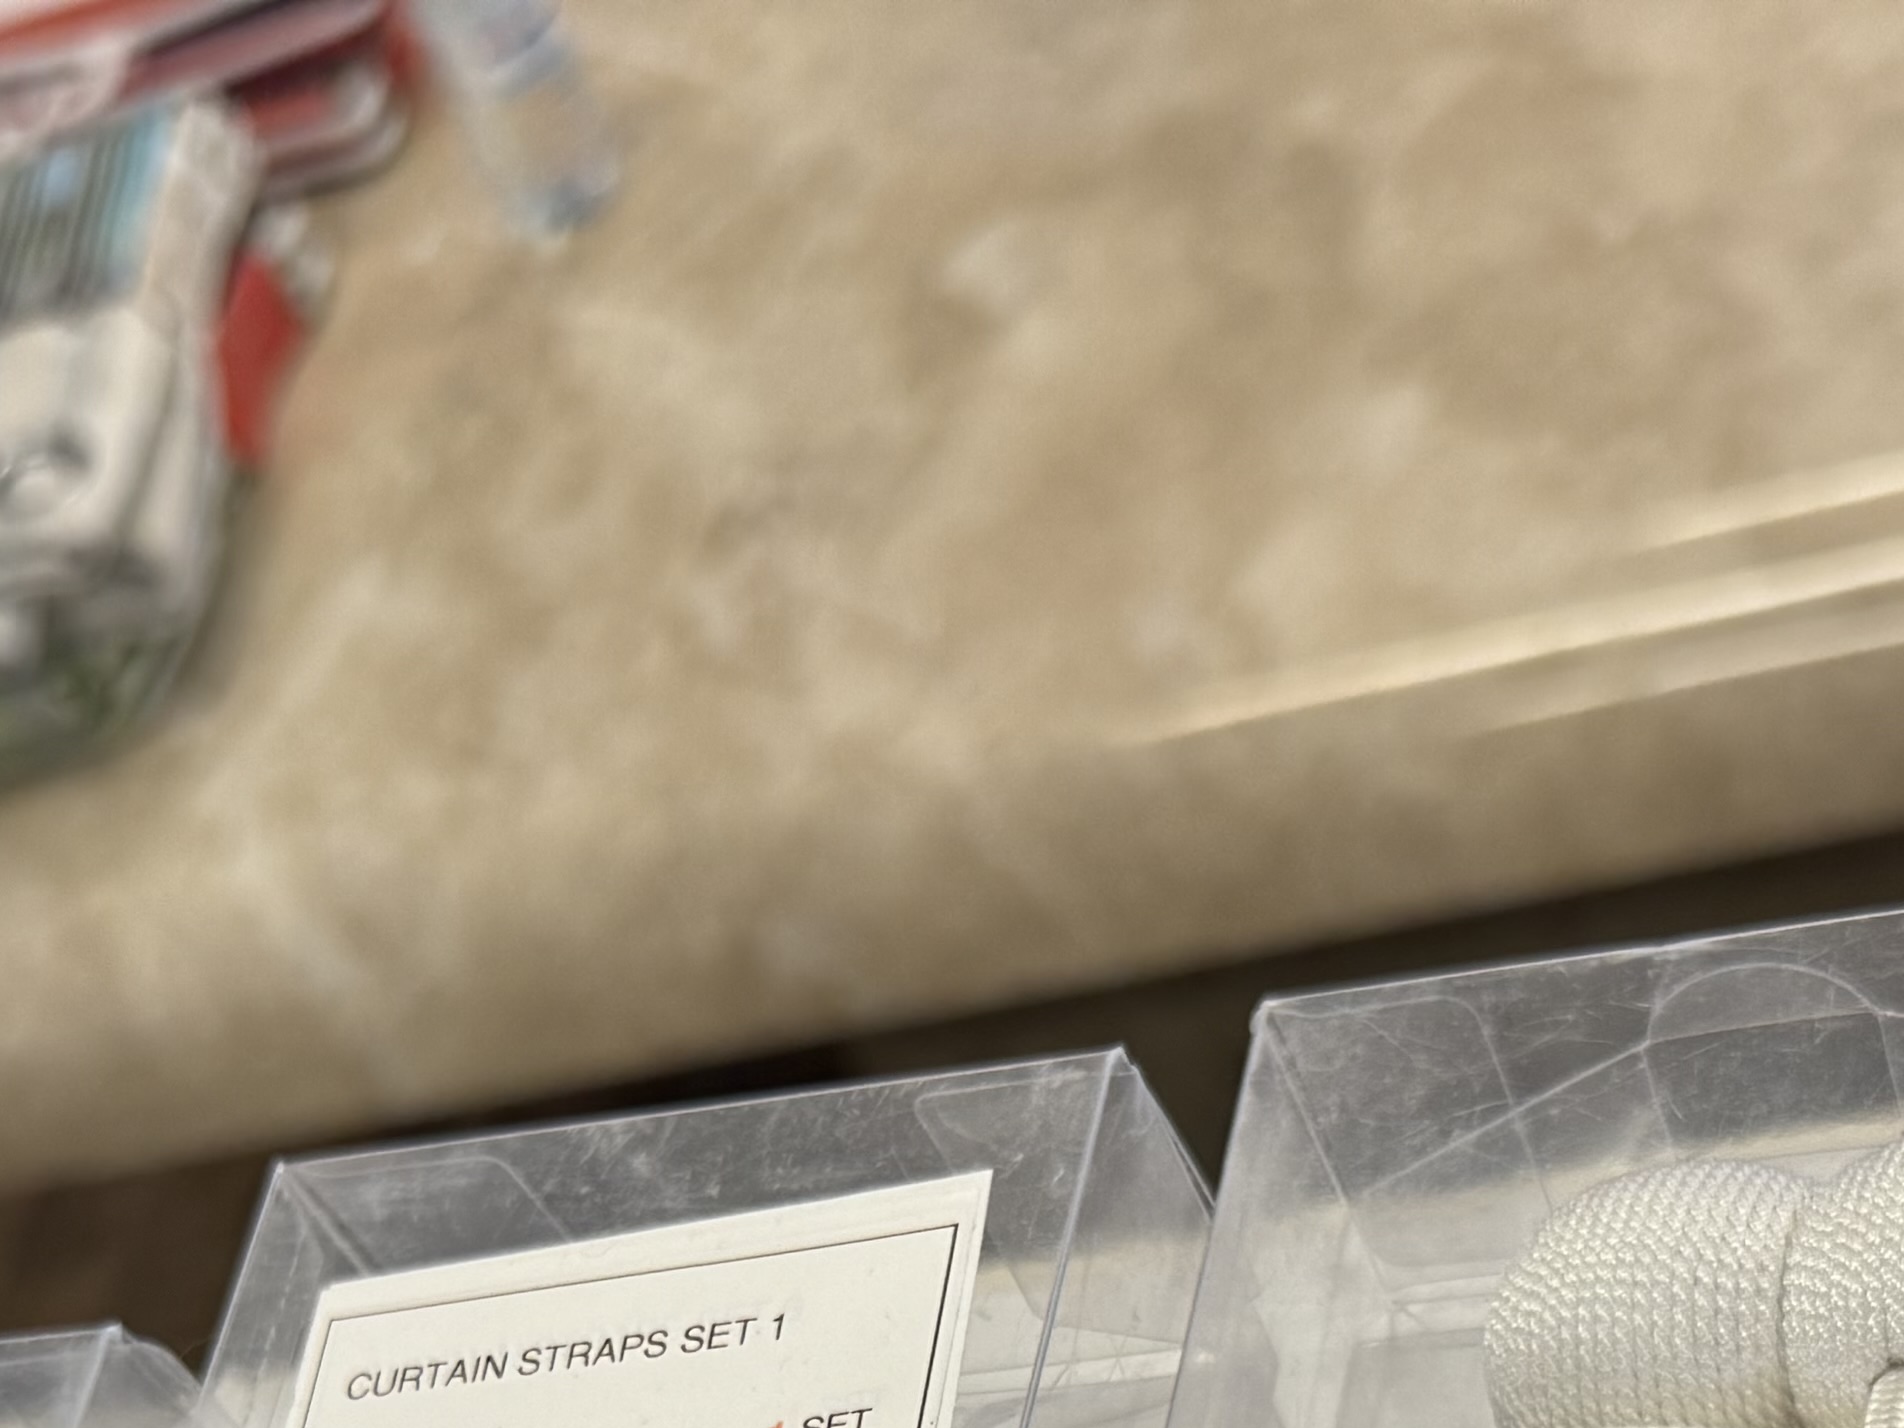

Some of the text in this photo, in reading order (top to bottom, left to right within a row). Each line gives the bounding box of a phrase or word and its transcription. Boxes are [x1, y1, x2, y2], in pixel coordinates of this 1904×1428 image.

[345, 1312, 787, 1401] CURTAIN STRAPS SET 1
